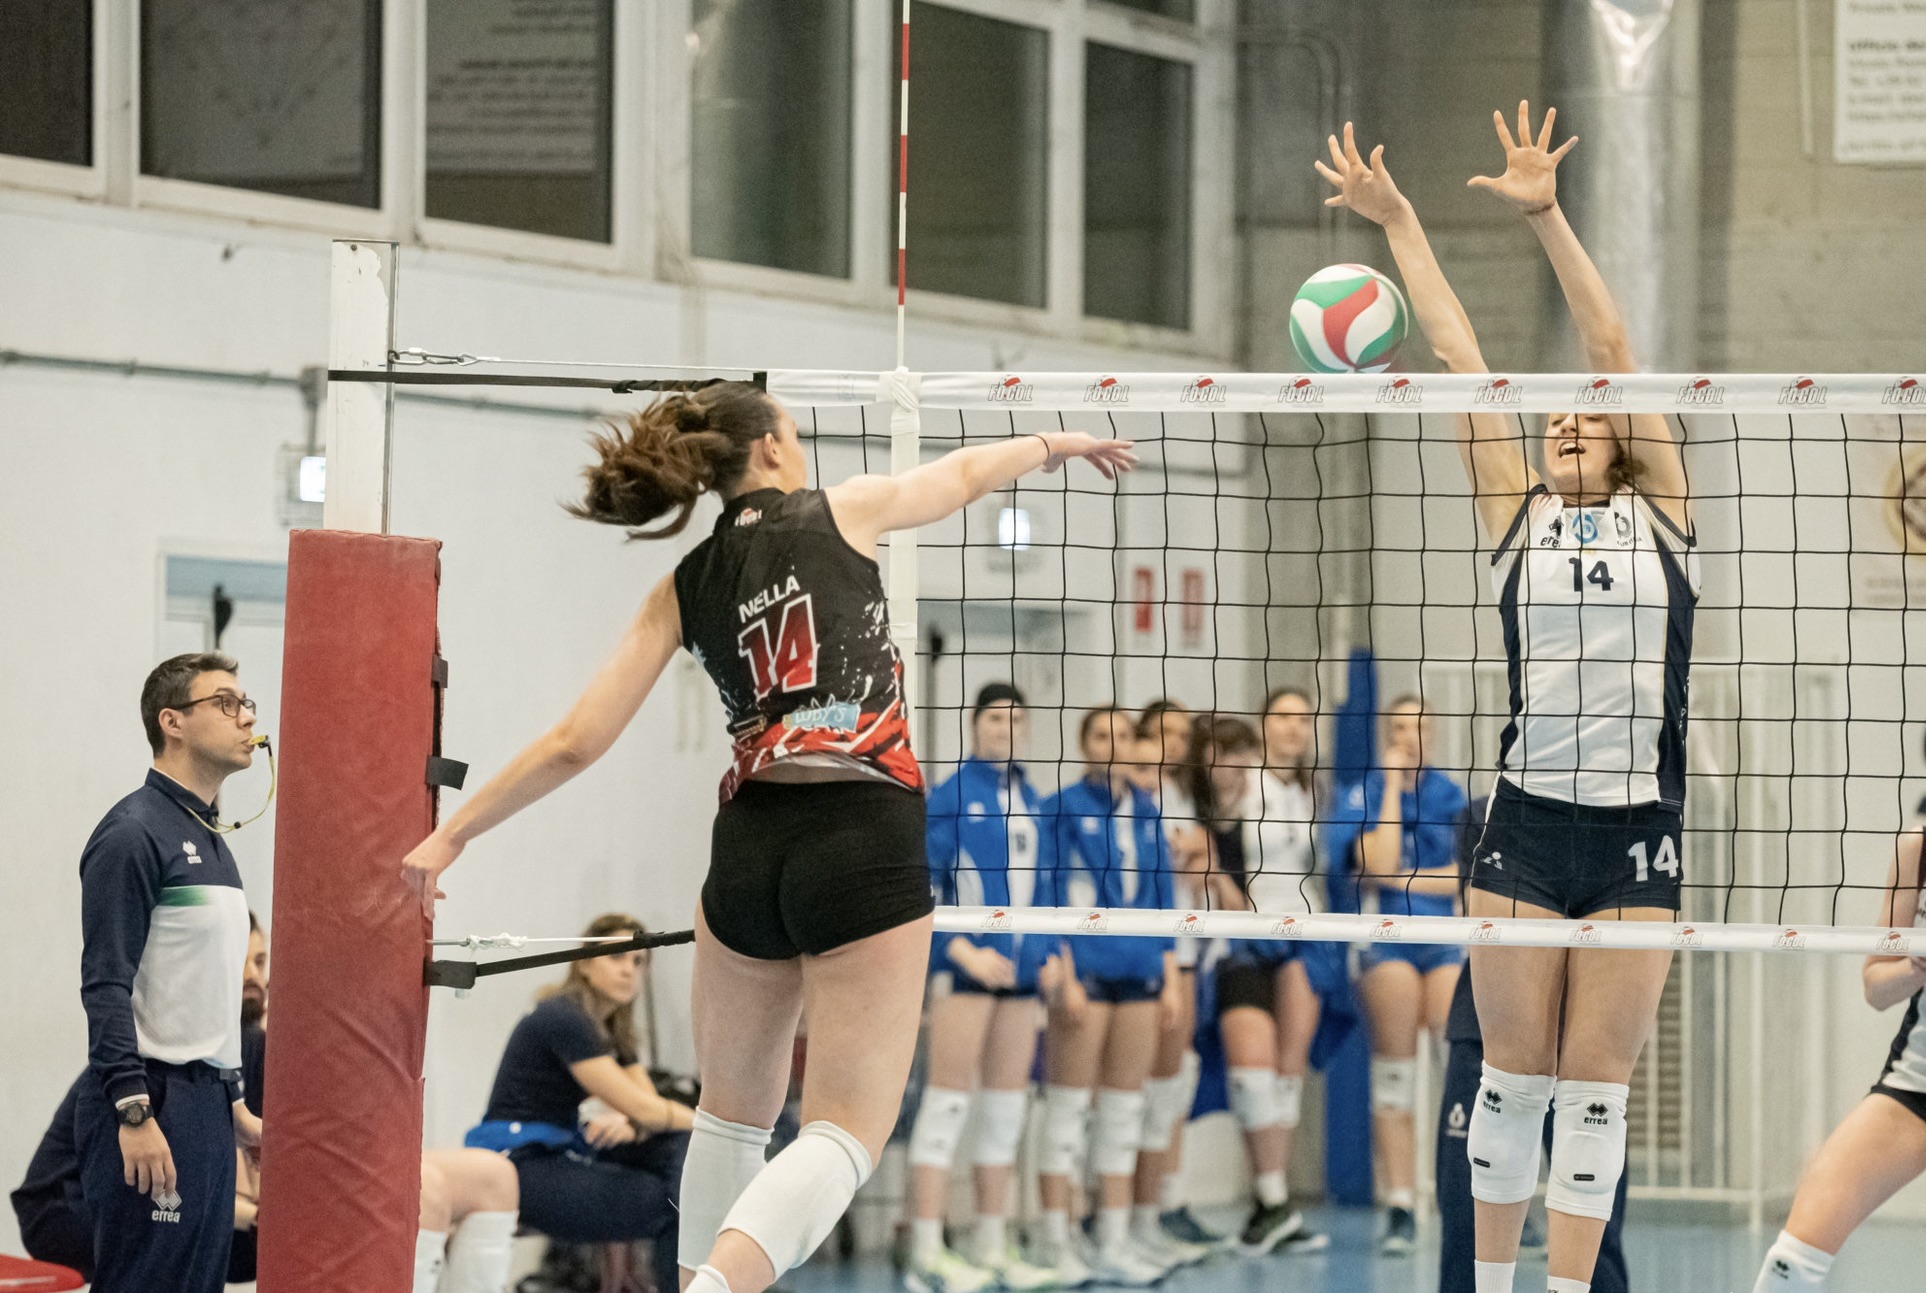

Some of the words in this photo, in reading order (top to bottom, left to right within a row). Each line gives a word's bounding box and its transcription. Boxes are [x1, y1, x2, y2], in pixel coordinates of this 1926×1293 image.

[1568, 556, 1614, 592] 14
[738, 575, 801, 623] NELLA
[737, 593, 820, 700] 14
[1627, 834, 1679, 882] 14
